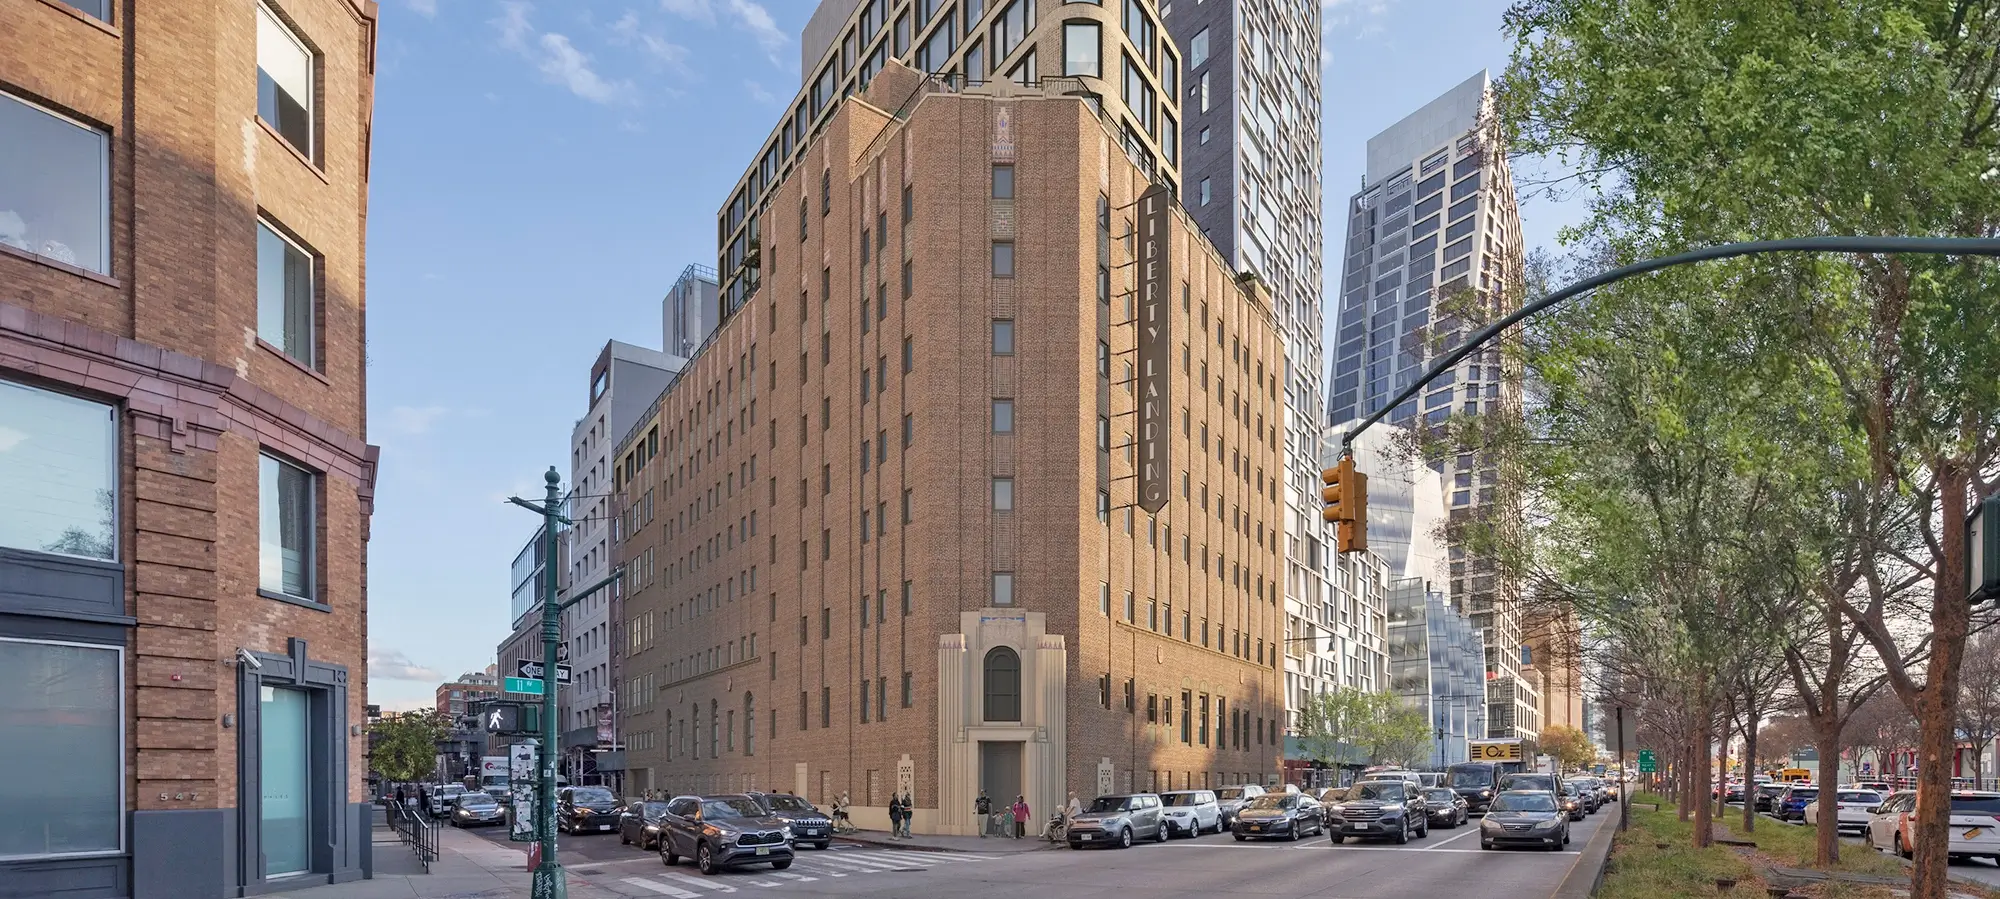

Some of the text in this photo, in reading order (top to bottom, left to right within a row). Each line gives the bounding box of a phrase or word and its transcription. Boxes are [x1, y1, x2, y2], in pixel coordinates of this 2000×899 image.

[1146, 197, 1160, 501] LIBERTY LANDING
[526, 666, 541, 675] ONE
[517, 680, 523, 691] 11
[160, 792, 199, 801] 547
